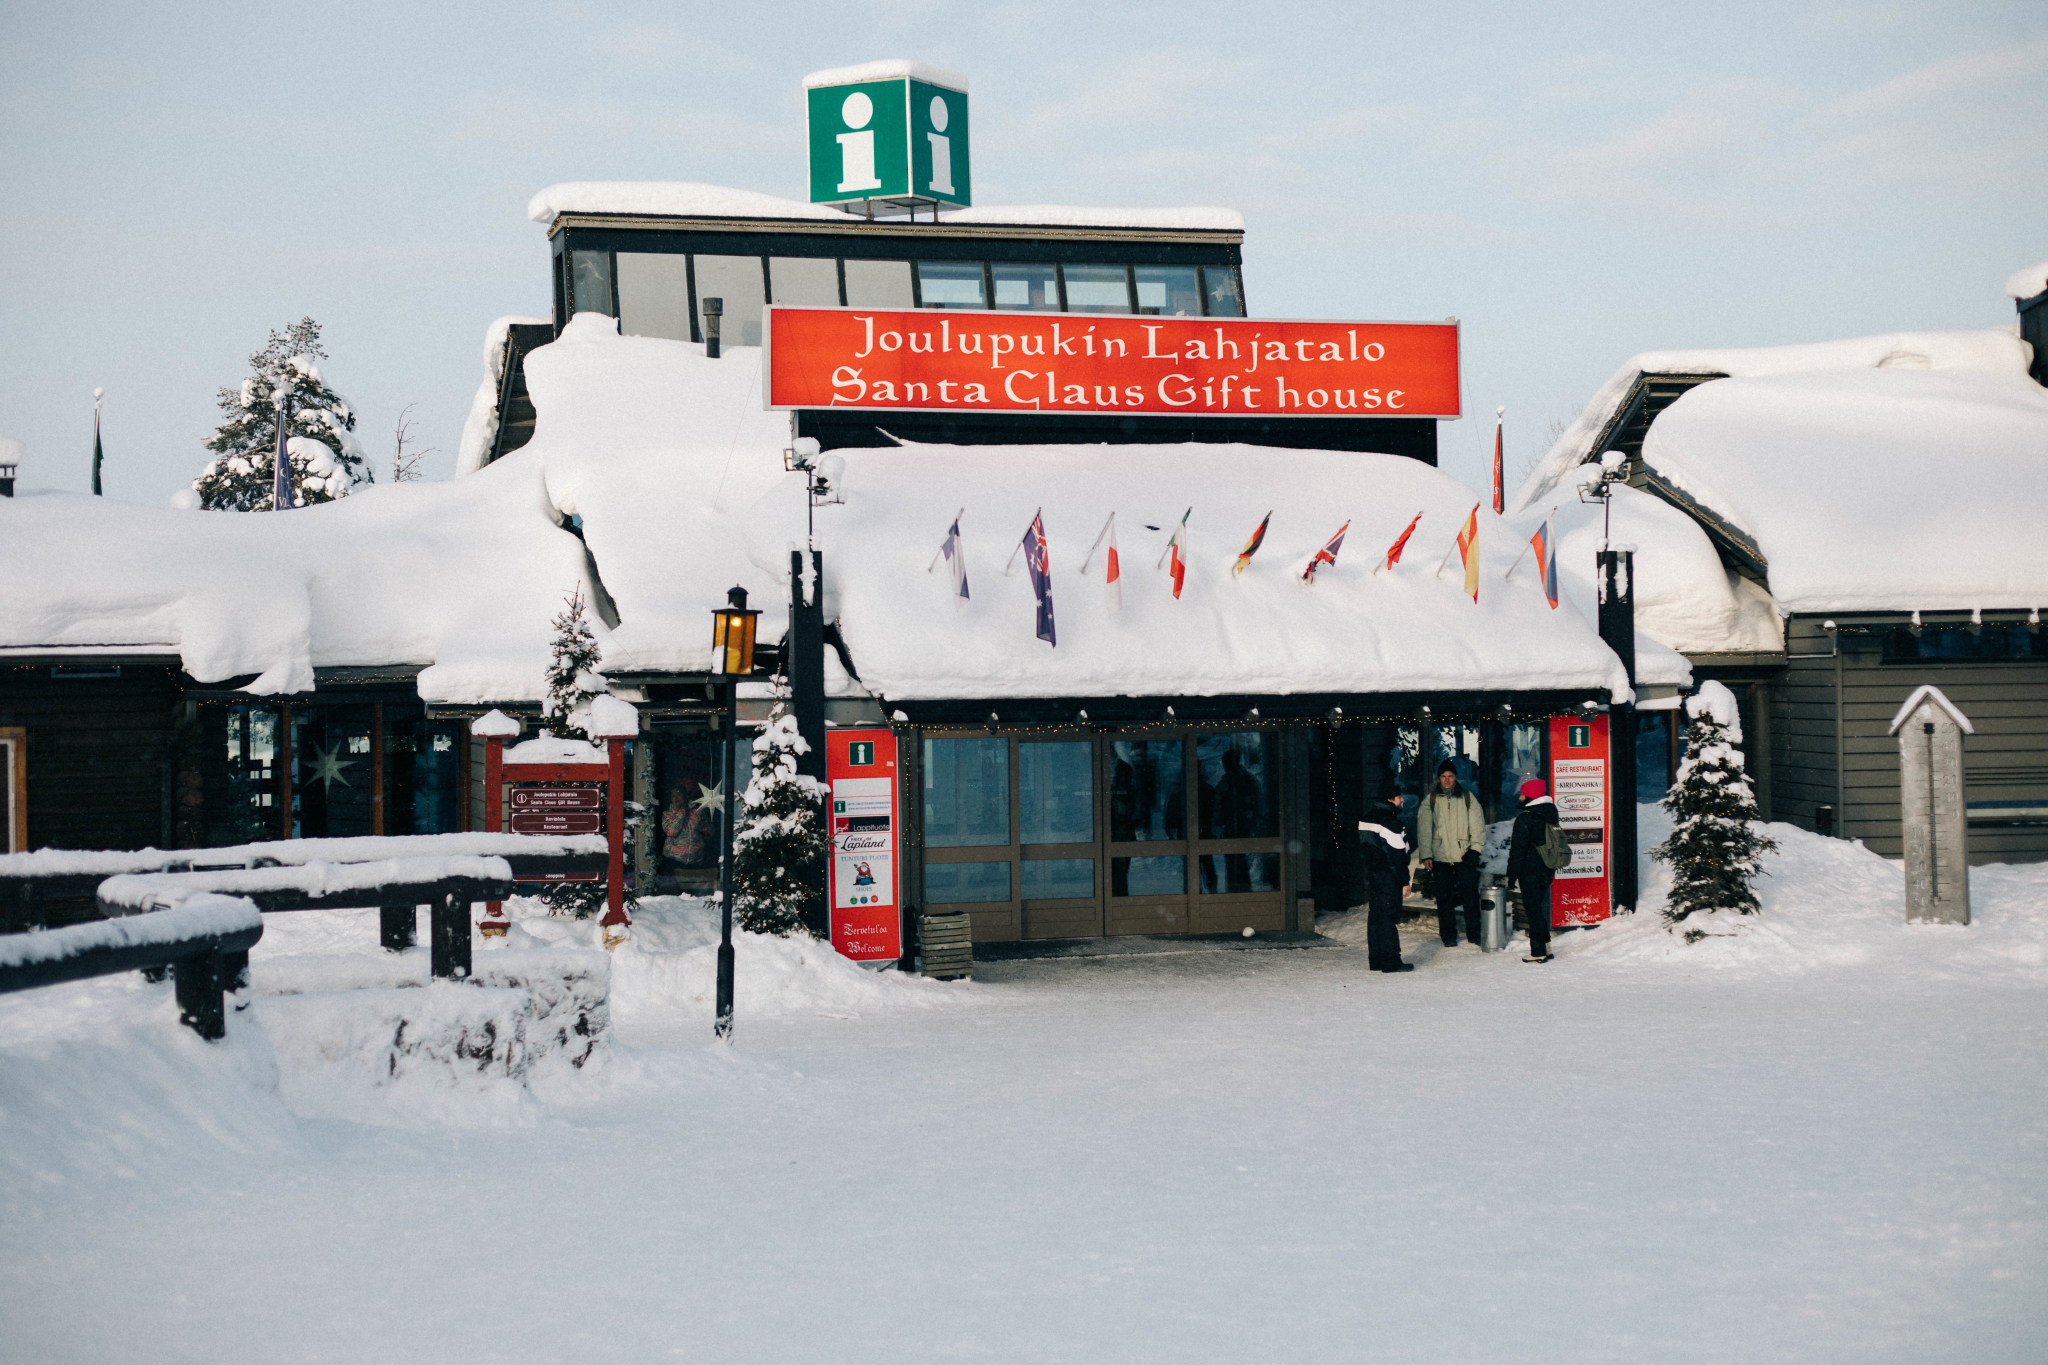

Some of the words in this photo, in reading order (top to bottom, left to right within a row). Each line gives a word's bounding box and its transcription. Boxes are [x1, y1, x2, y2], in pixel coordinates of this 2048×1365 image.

[853, 315, 1129, 369] Joulupukin
[1140, 324, 1385, 373] Lahjatalo
[830, 365, 991, 407] Santa
[1004, 369, 1145, 411] Claus
[1157, 373, 1262, 409] Gift
[1274, 375, 1406, 409] house
[1569, 765, 1602, 773] RESTAURANT
[1559, 781, 1599, 789] KIRJONAHKA
[853, 823, 891, 832] Lappituote
[840, 834, 887, 852] Lapland
[843, 922, 888, 936] Tervetuloa
[846, 941, 886, 954] Welcome
